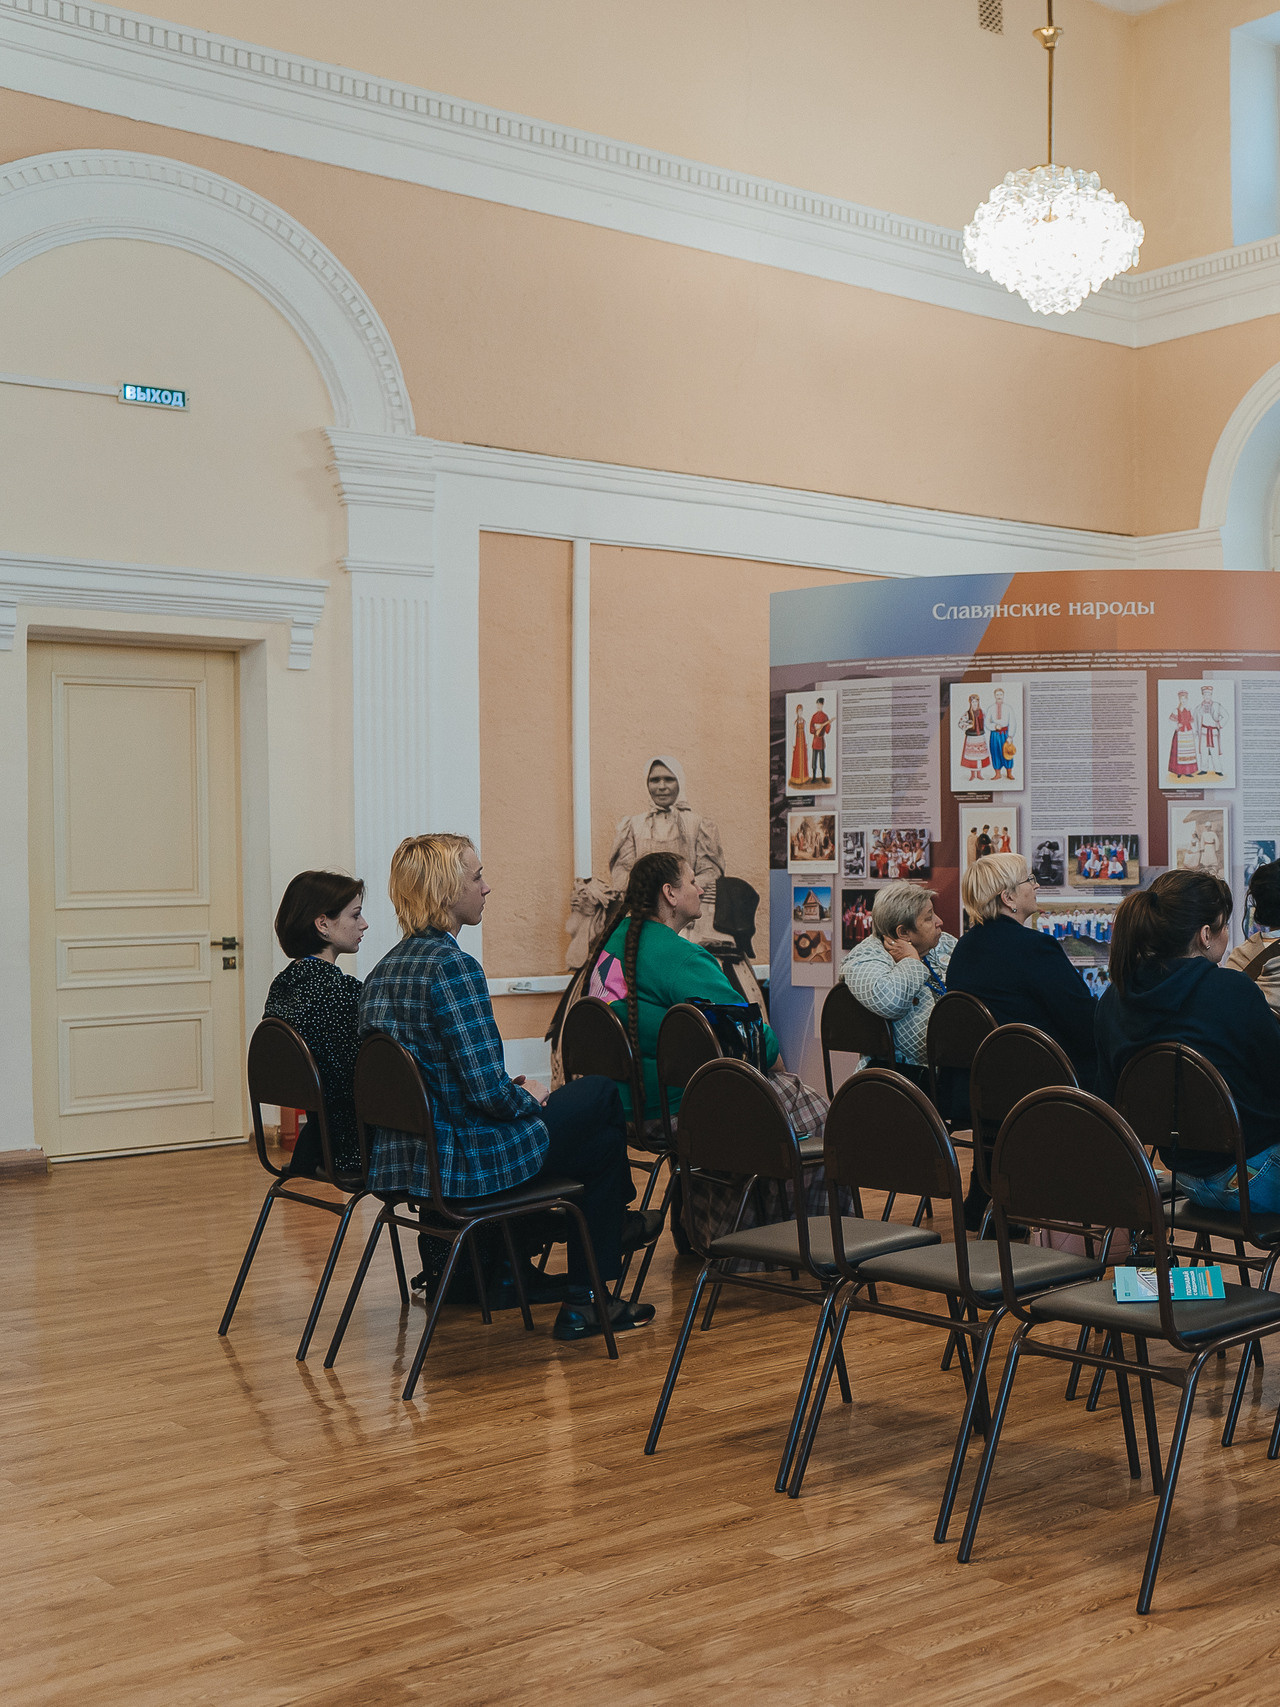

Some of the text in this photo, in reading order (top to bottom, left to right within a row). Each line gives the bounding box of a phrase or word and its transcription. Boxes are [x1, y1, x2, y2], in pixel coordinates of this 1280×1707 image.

[124, 385, 185, 408] ВЫХОД
[931, 600, 1156, 621] Славянские народы
